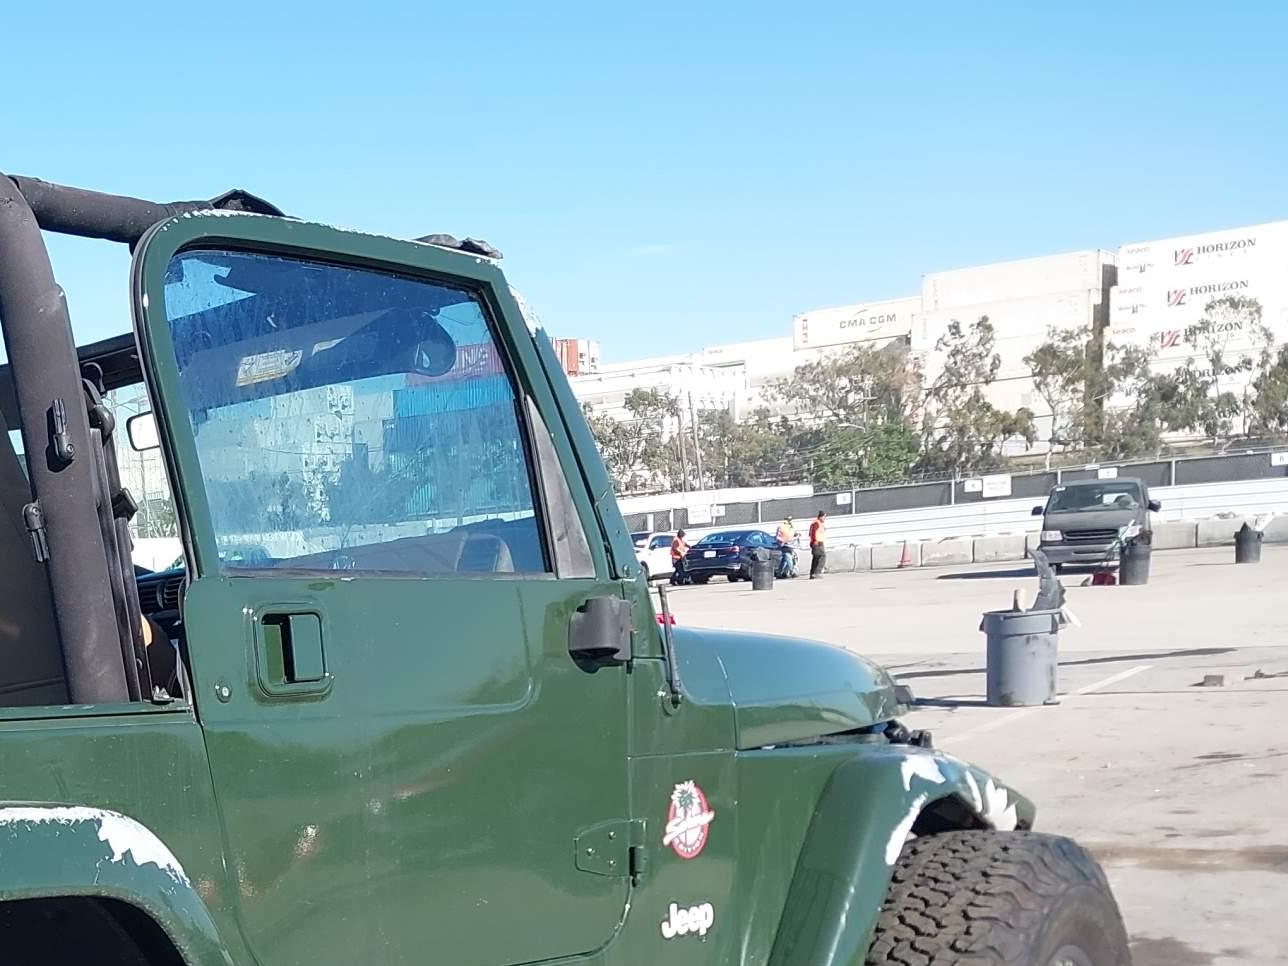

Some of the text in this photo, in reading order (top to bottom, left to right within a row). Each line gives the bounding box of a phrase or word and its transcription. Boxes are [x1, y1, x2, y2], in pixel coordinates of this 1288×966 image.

[1196, 238, 1257, 255] HORIZON
[1189, 280, 1249, 295] HORIZON
[839, 313, 897, 329] CMA CGM
[661, 902, 714, 938] Jeep
